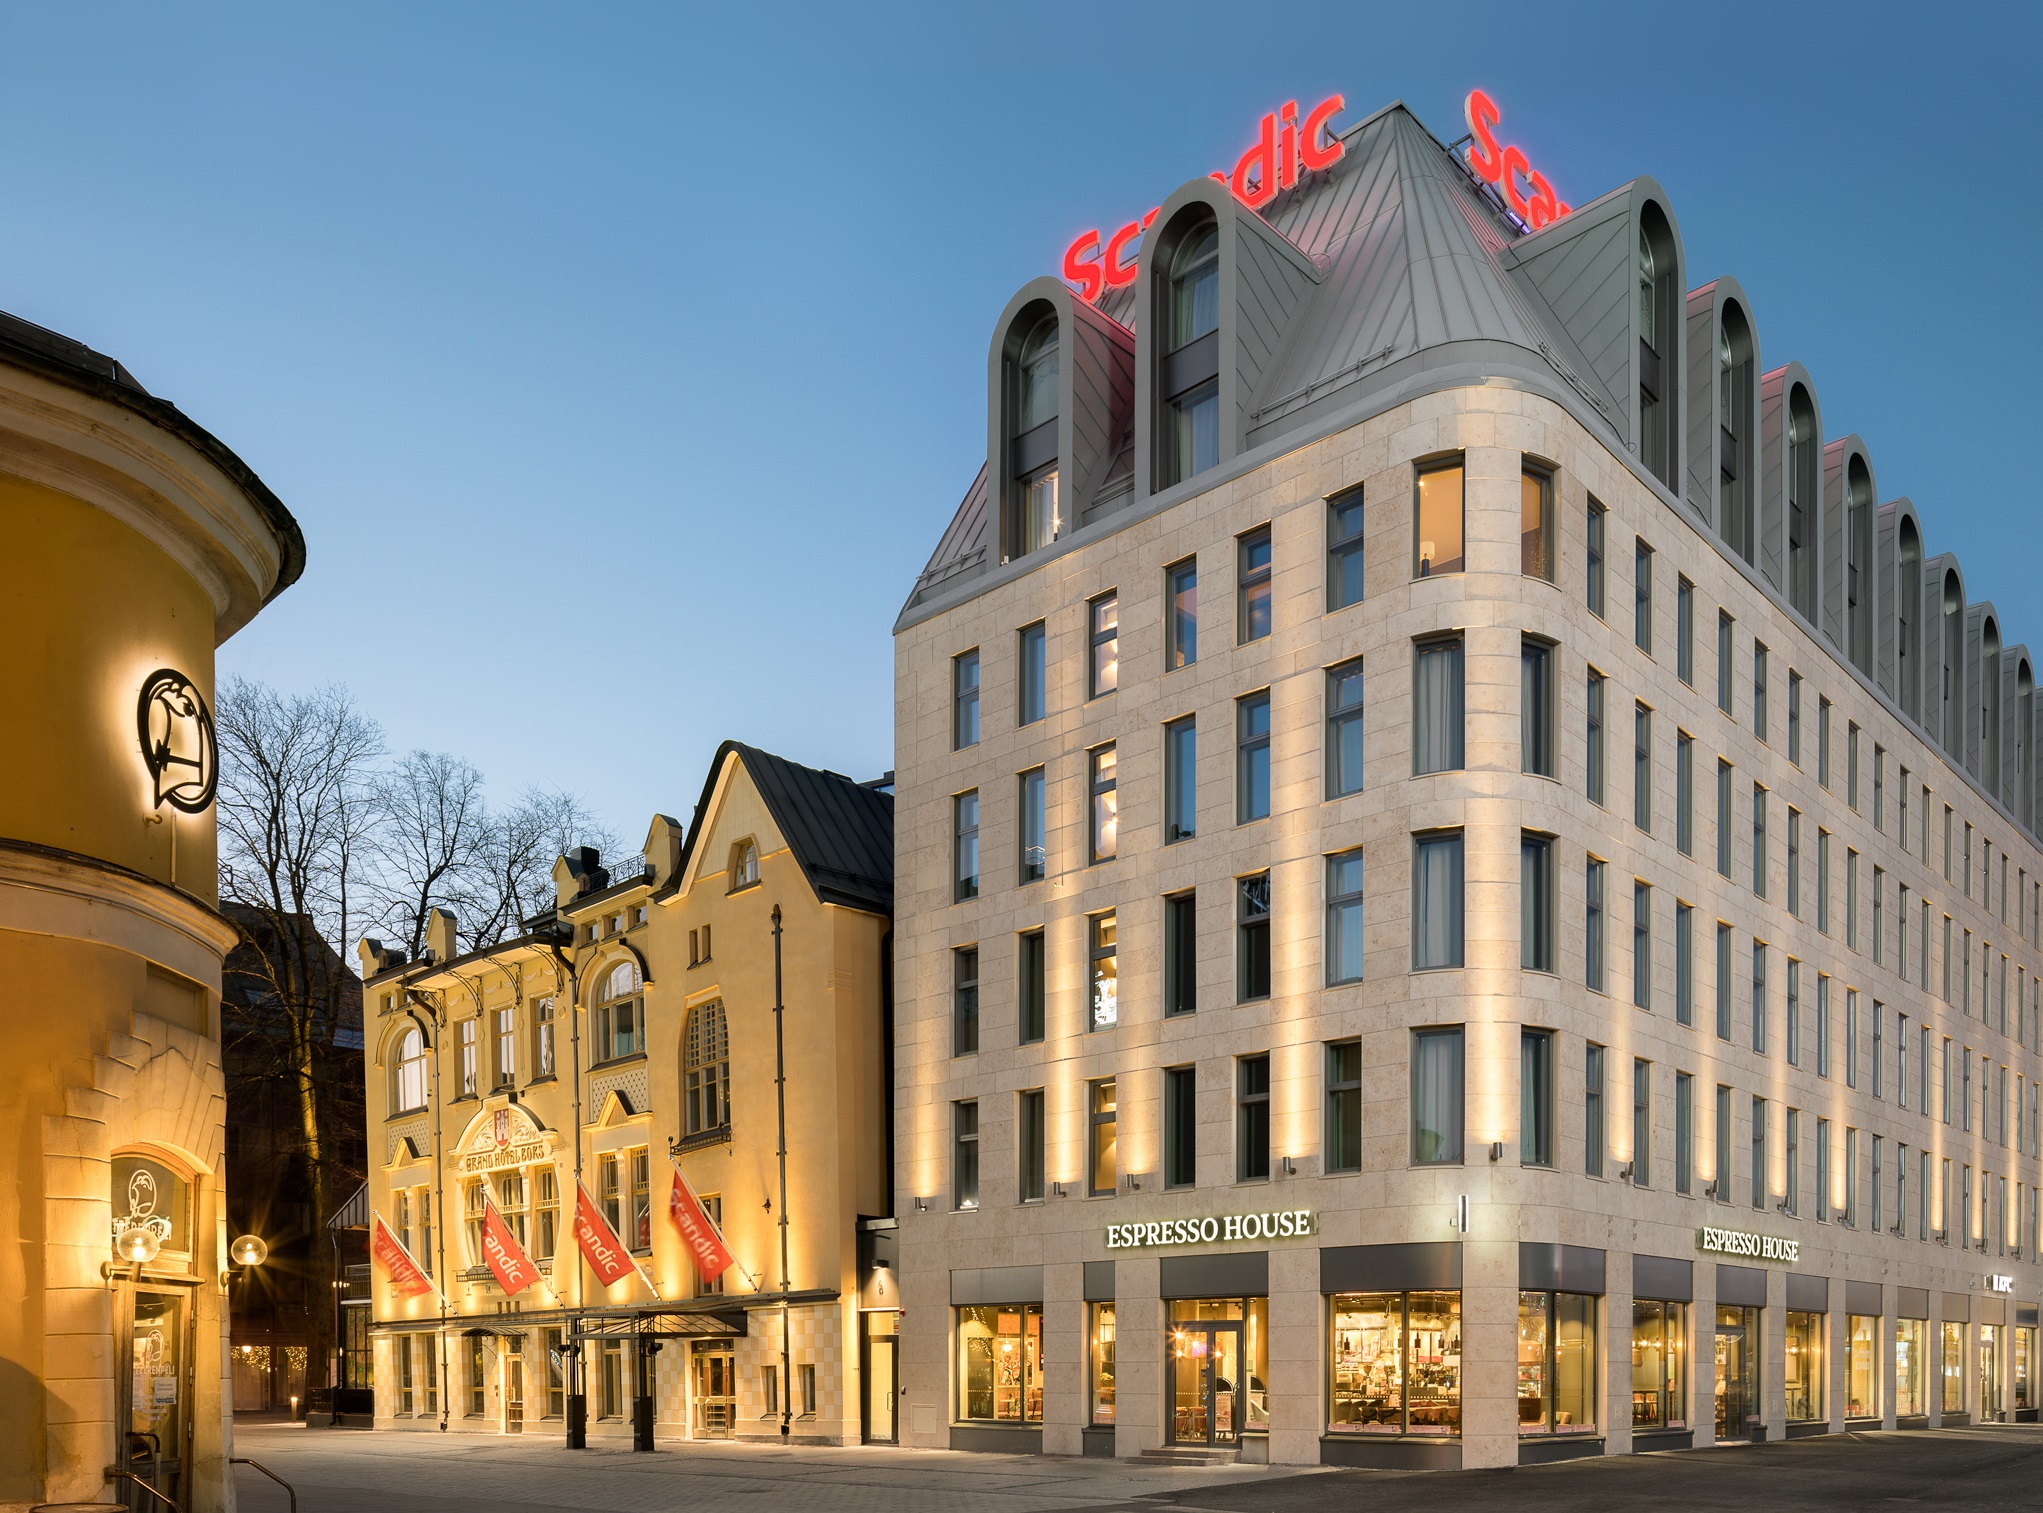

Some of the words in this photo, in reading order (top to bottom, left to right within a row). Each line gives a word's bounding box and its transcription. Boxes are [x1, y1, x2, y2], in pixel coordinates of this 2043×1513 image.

[466, 1154, 493, 1172] GRAND
[1107, 1217, 1218, 1248] ESPRESSO
[1223, 1210, 1311, 1240] HOUSE
[1703, 1226, 1760, 1256] ESPRESSO
[1762, 1236, 1799, 1262] HOUSE
